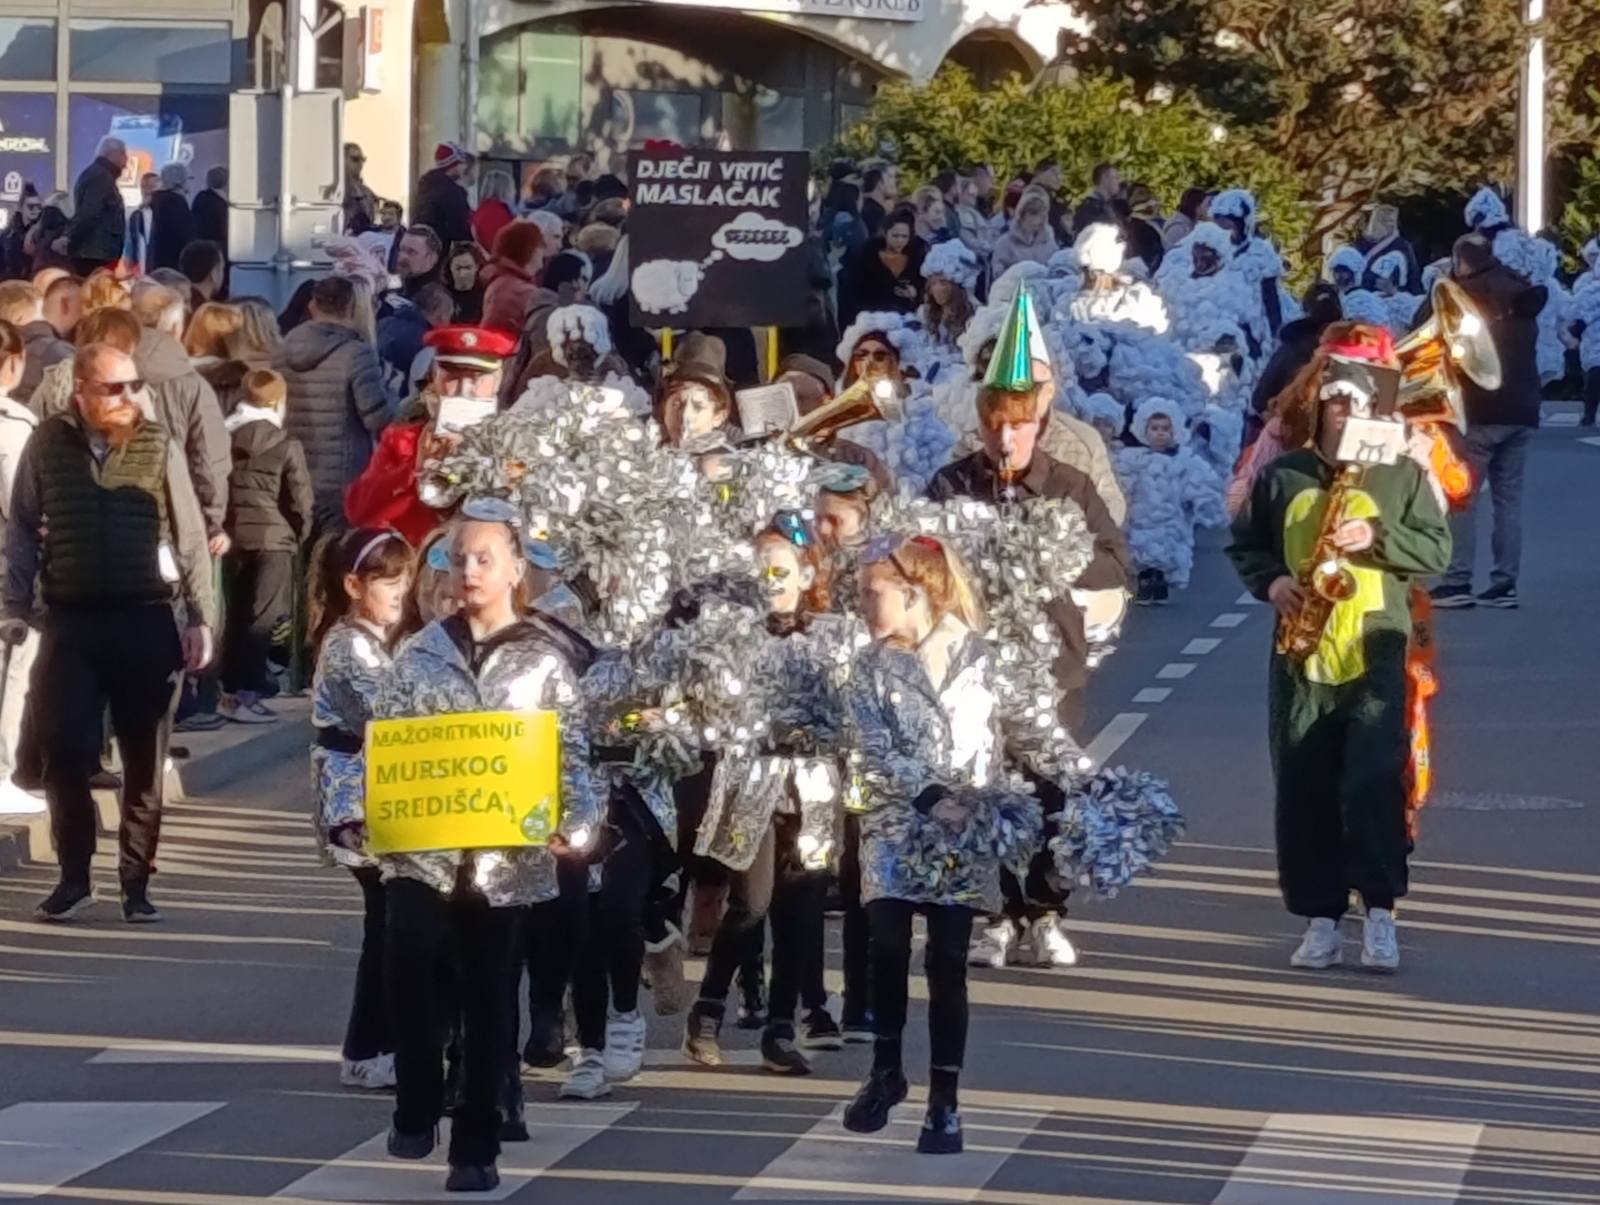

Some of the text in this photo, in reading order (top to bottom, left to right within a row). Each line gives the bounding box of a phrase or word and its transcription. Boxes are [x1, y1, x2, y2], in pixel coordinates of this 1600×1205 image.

[636, 156, 784, 181] DJEČJI VRTIĆ
[636, 181, 781, 208] MASLAČAK
[376, 755, 507, 784] MURSKOG
